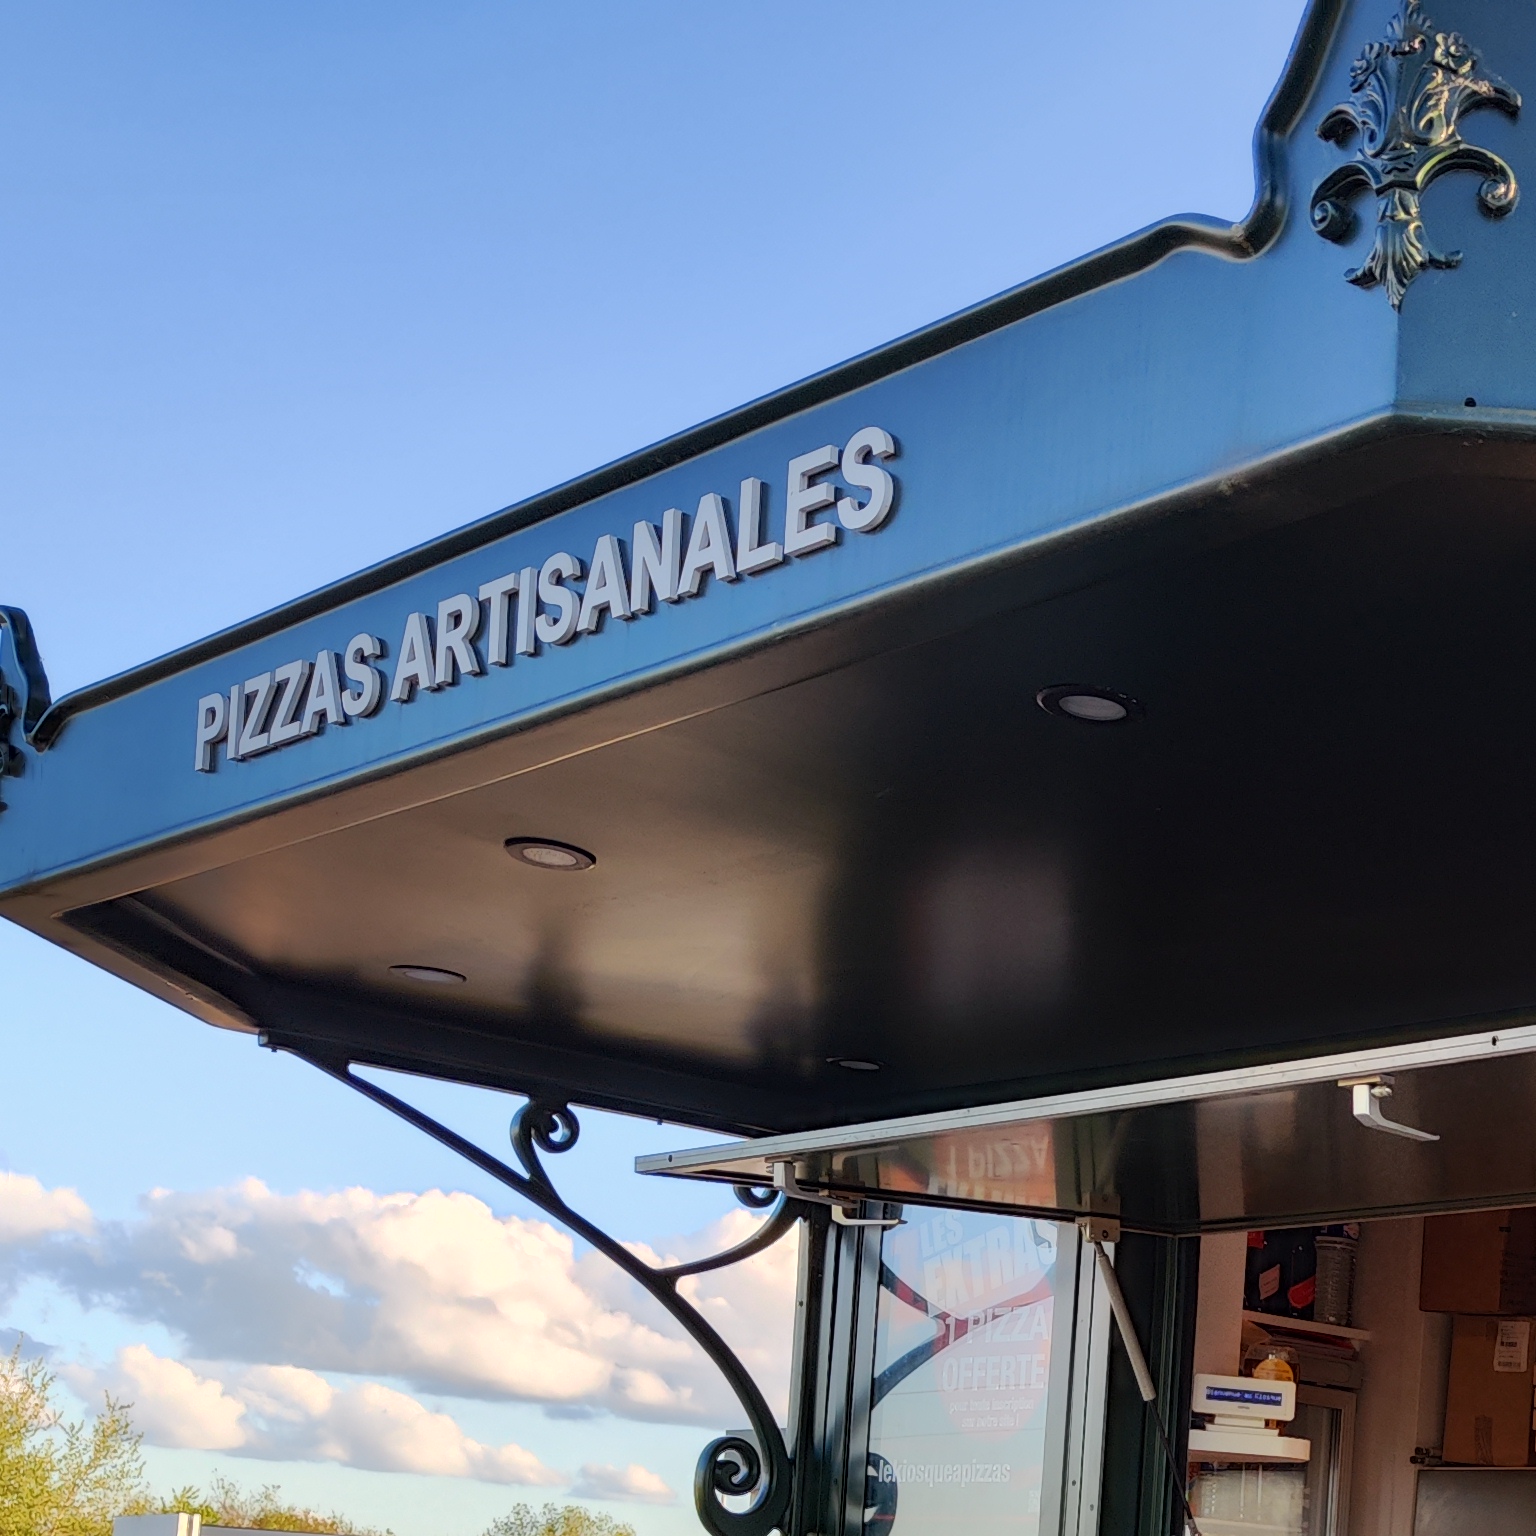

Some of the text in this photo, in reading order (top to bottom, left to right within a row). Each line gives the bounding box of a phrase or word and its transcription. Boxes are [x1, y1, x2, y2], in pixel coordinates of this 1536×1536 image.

[194, 425, 898, 774] PIZZAS ARTISANALES
[920, 1212, 964, 1257] LES
[967, 1304, 1048, 1343] PIZZA
[942, 1354, 1046, 1391] OFFERTE
[878, 1460, 1010, 1486] lekiosqueapizzas
